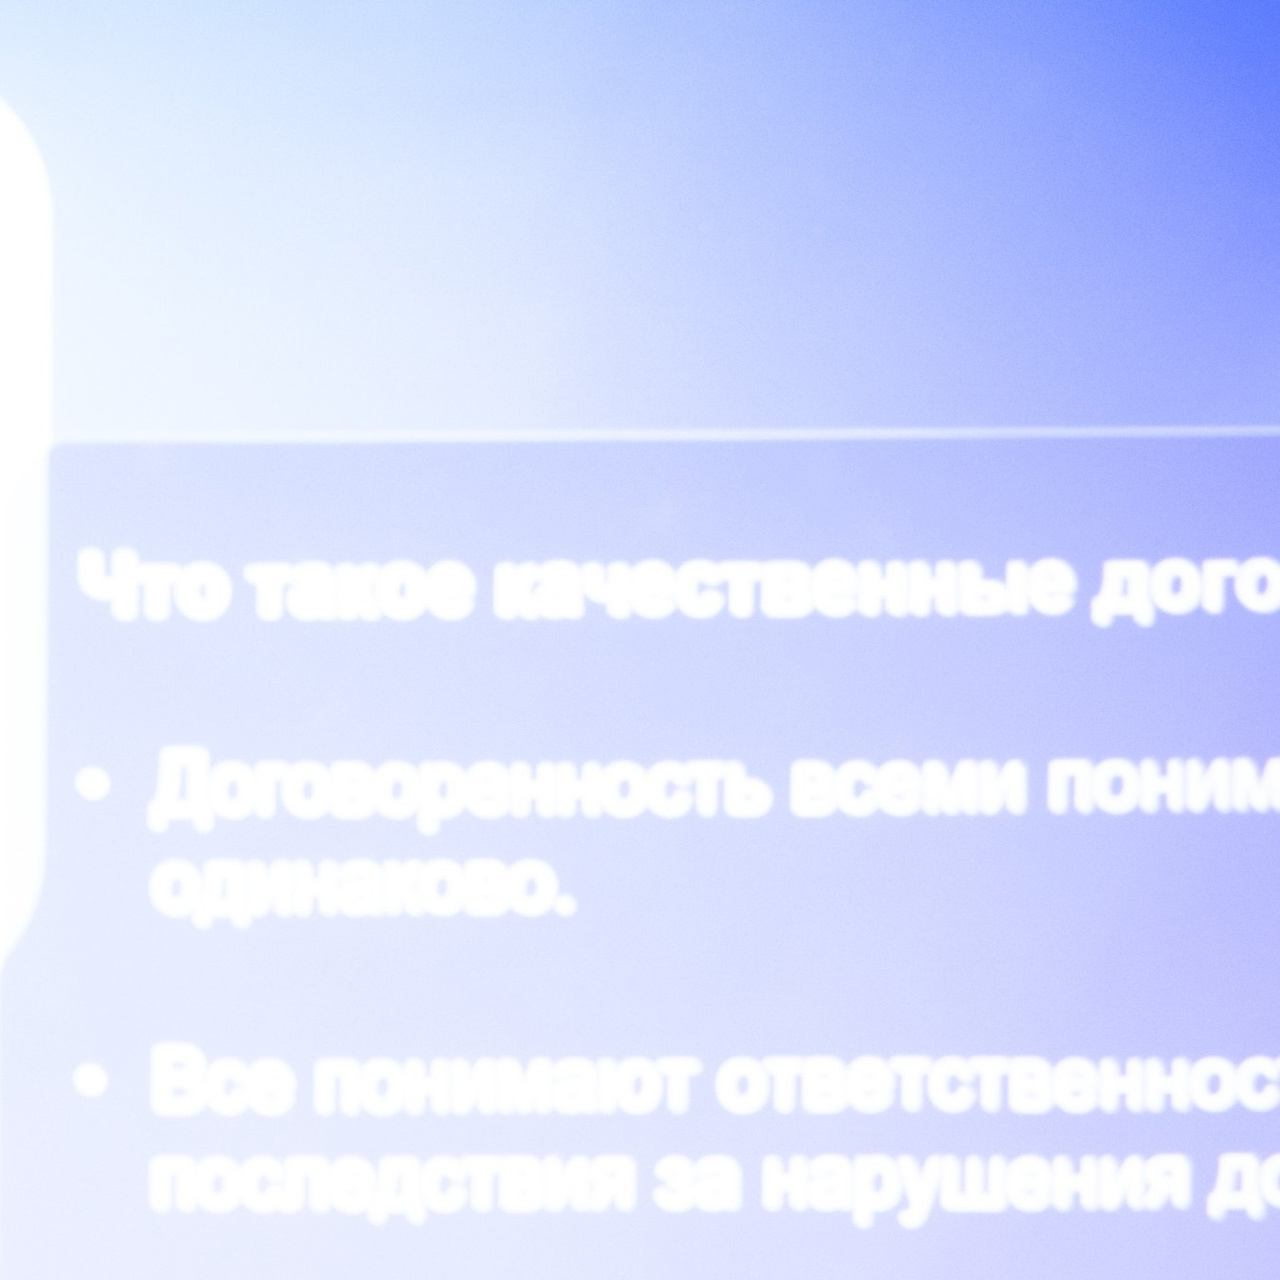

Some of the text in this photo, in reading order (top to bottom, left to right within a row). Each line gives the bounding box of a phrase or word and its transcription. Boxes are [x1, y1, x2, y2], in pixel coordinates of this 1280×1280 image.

[76, 547, 233, 623] Что
[243, 559, 478, 622] такое
[492, 557, 1078, 621] качественные
[146, 744, 774, 836] Договоренность
[788, 758, 1028, 819] всеми
[148, 857, 577, 929] одинаково.
[150, 1041, 1280, 1117] Все понимают ответственнос
[148, 1153, 637, 1225] последствия
[652, 1153, 743, 1213] за
[761, 1152, 1192, 1229] нарушения
